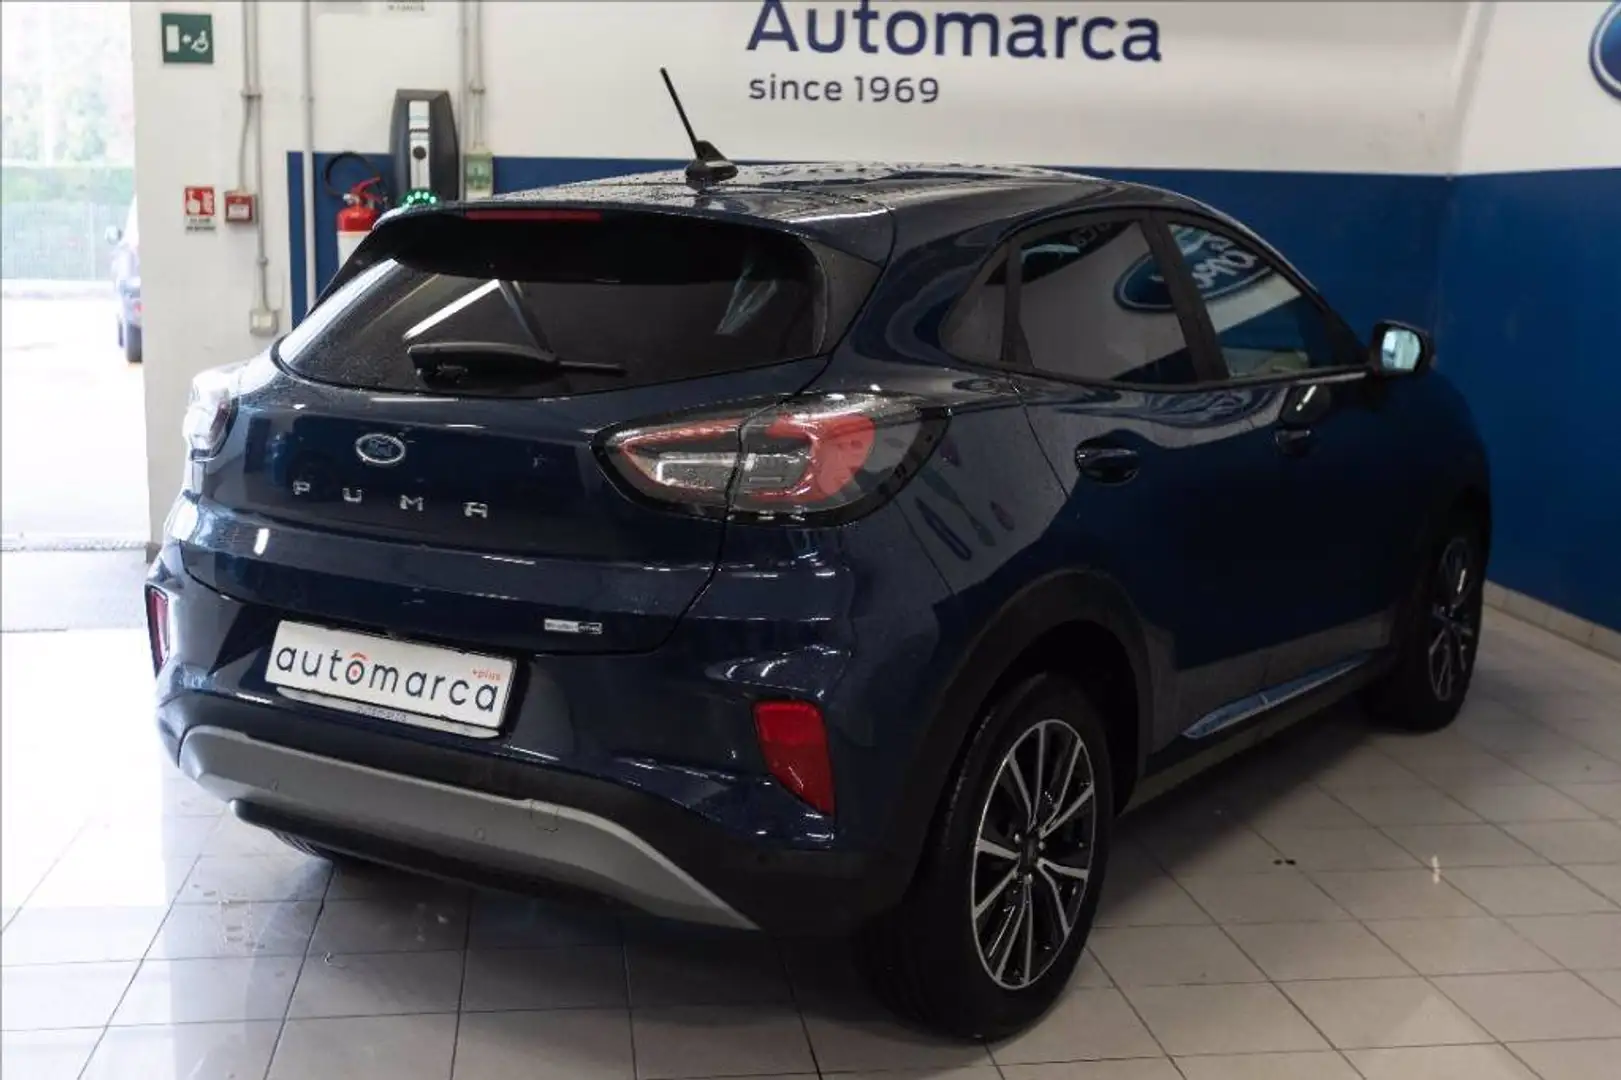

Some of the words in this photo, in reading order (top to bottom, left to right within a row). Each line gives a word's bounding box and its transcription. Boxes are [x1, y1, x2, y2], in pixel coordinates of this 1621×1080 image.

[746, 0, 1162, 62] Automarca
[749, 73, 843, 101] since
[854, 75, 940, 103] 1969
[292, 479, 489, 518] PUMA
